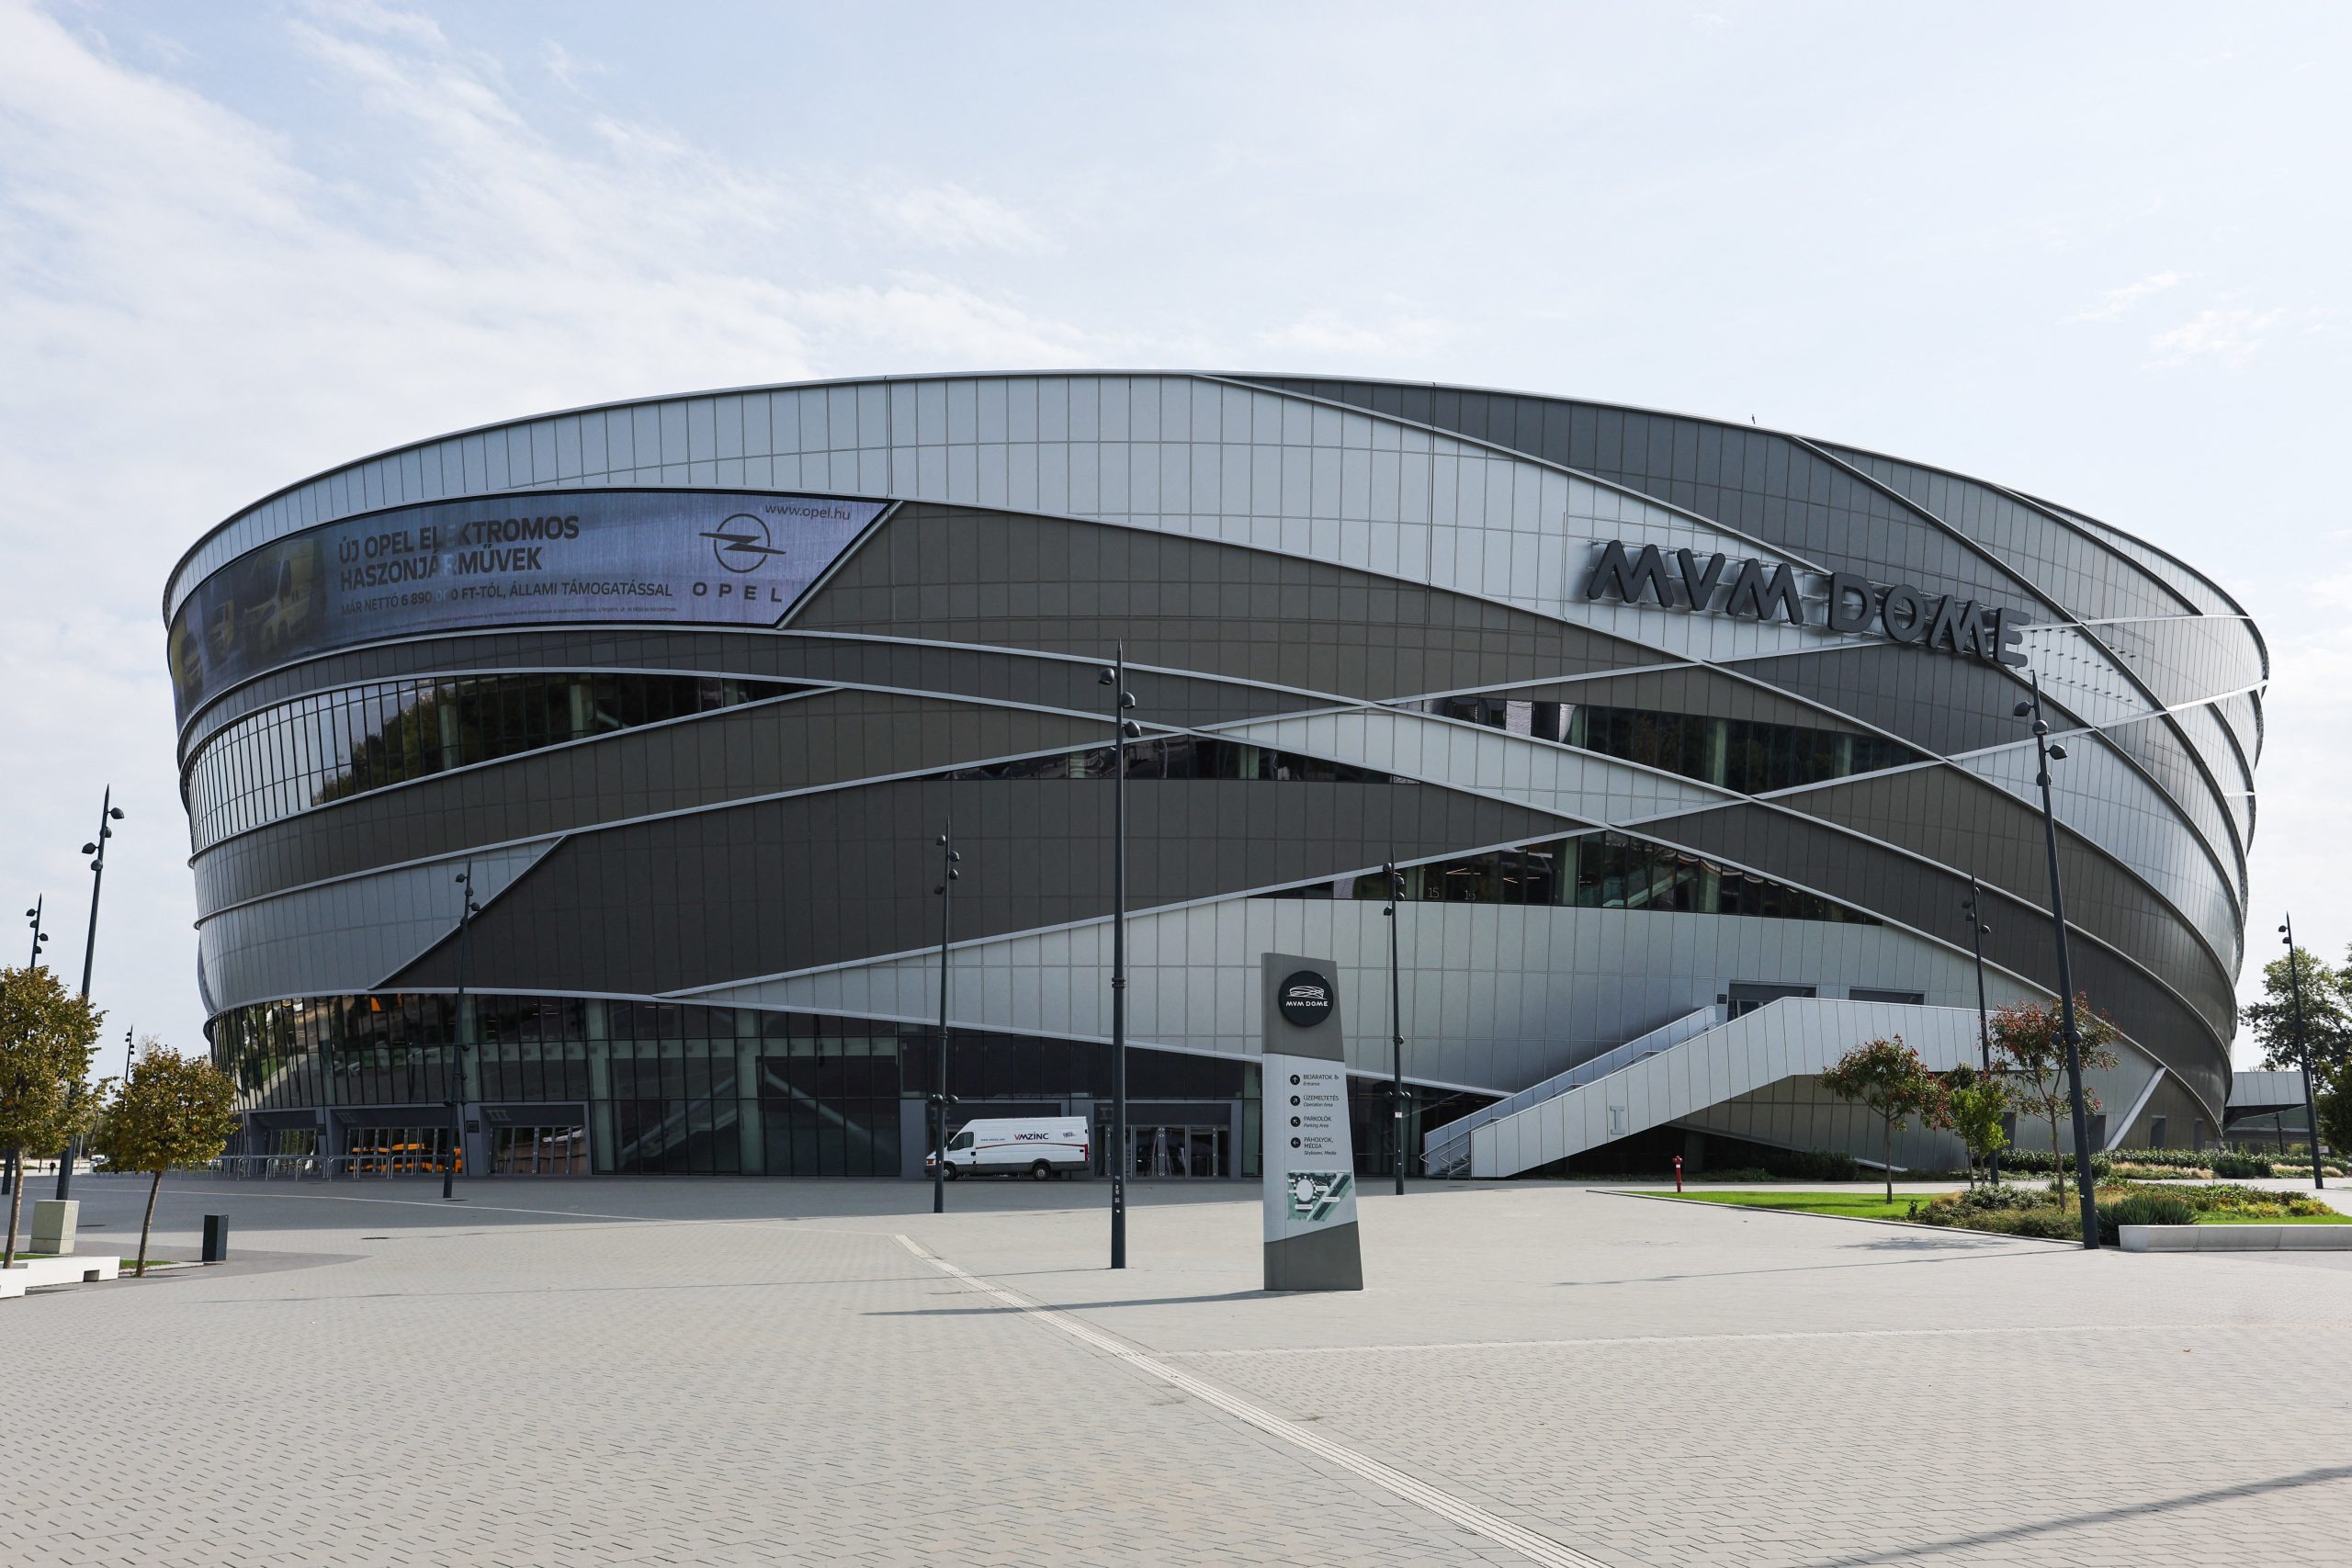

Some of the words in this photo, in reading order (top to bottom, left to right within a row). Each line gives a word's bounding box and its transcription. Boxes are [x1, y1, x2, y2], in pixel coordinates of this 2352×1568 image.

[764, 503, 851, 521] www.opel.hu
[338, 535, 360, 564] ÚJ
[364, 530, 415, 559] OPEL
[419, 514, 580, 550] ELKTROMOS
[342, 599, 363, 616] MÁR
[365, 592, 399, 612] NETTÓ
[401, 593, 409, 606] 6
[411, 591, 433, 605] 890
[461, 581, 506, 600] FT-TÓL,
[509, 581, 557, 597] ÁLLAMI
[561, 580, 673, 597] TÁMOGATÁSSAL
[692, 581, 783, 604] OPEL
[1586, 539, 1804, 626] MVM
[1826, 571, 2031, 668] DOME
[1428, 886, 1441, 898] 15
